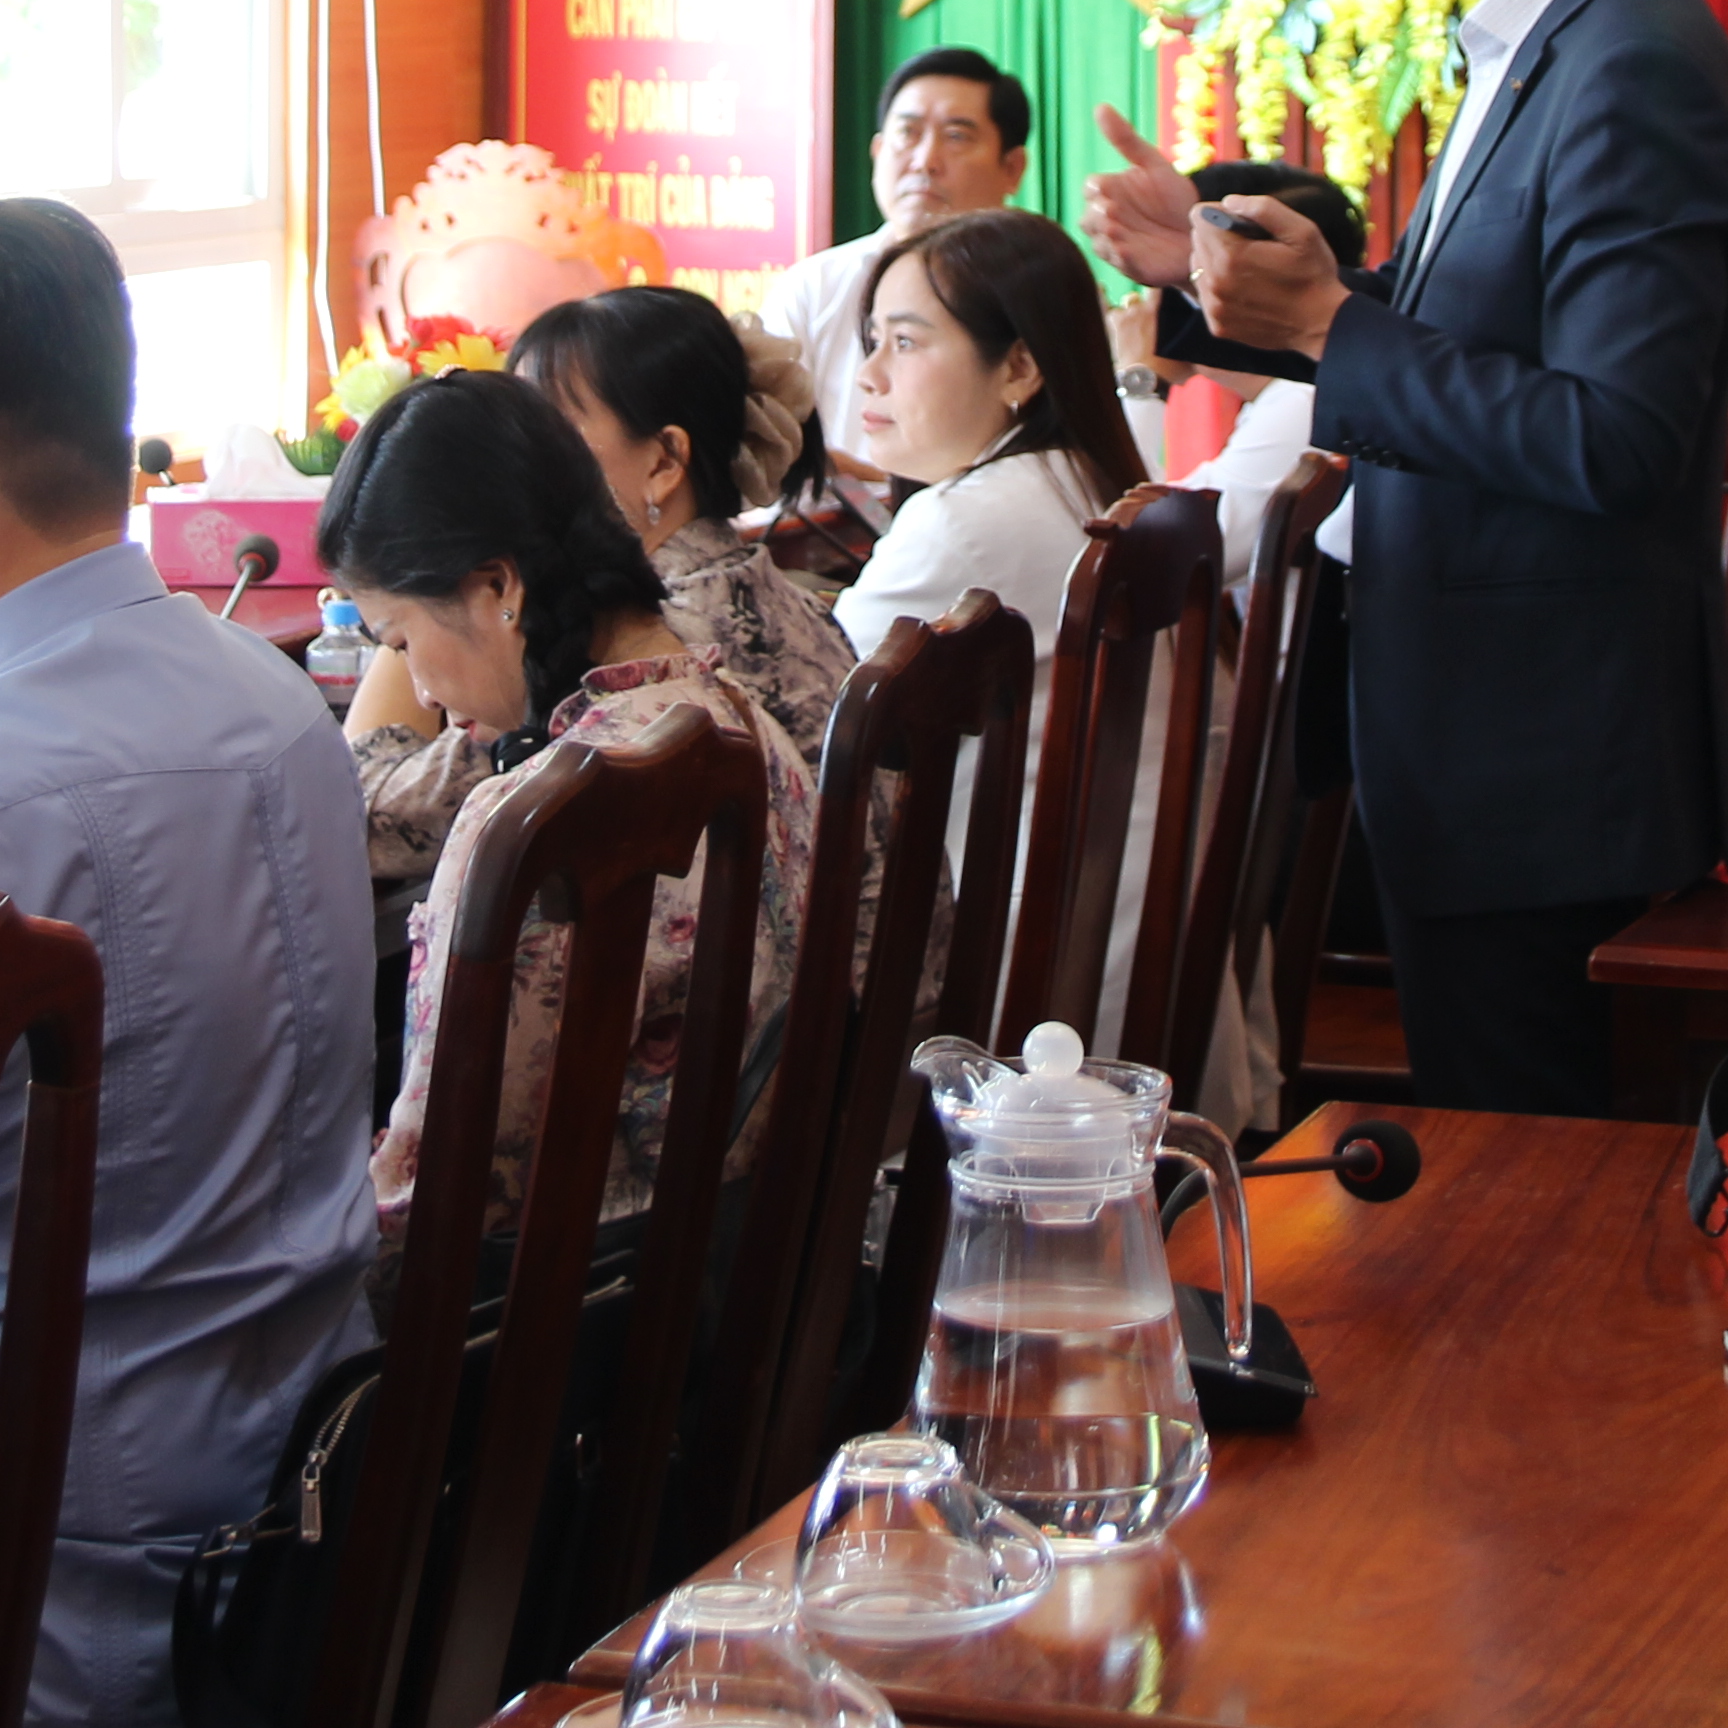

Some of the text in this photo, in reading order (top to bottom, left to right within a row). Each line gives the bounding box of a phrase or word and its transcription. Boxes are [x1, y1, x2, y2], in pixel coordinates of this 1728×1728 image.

[585, 71, 624, 144] SỰ
[624, 68, 687, 137] ĐOÀN
[617, 160, 657, 226] TRÍ
[659, 153, 707, 229] CỦA
